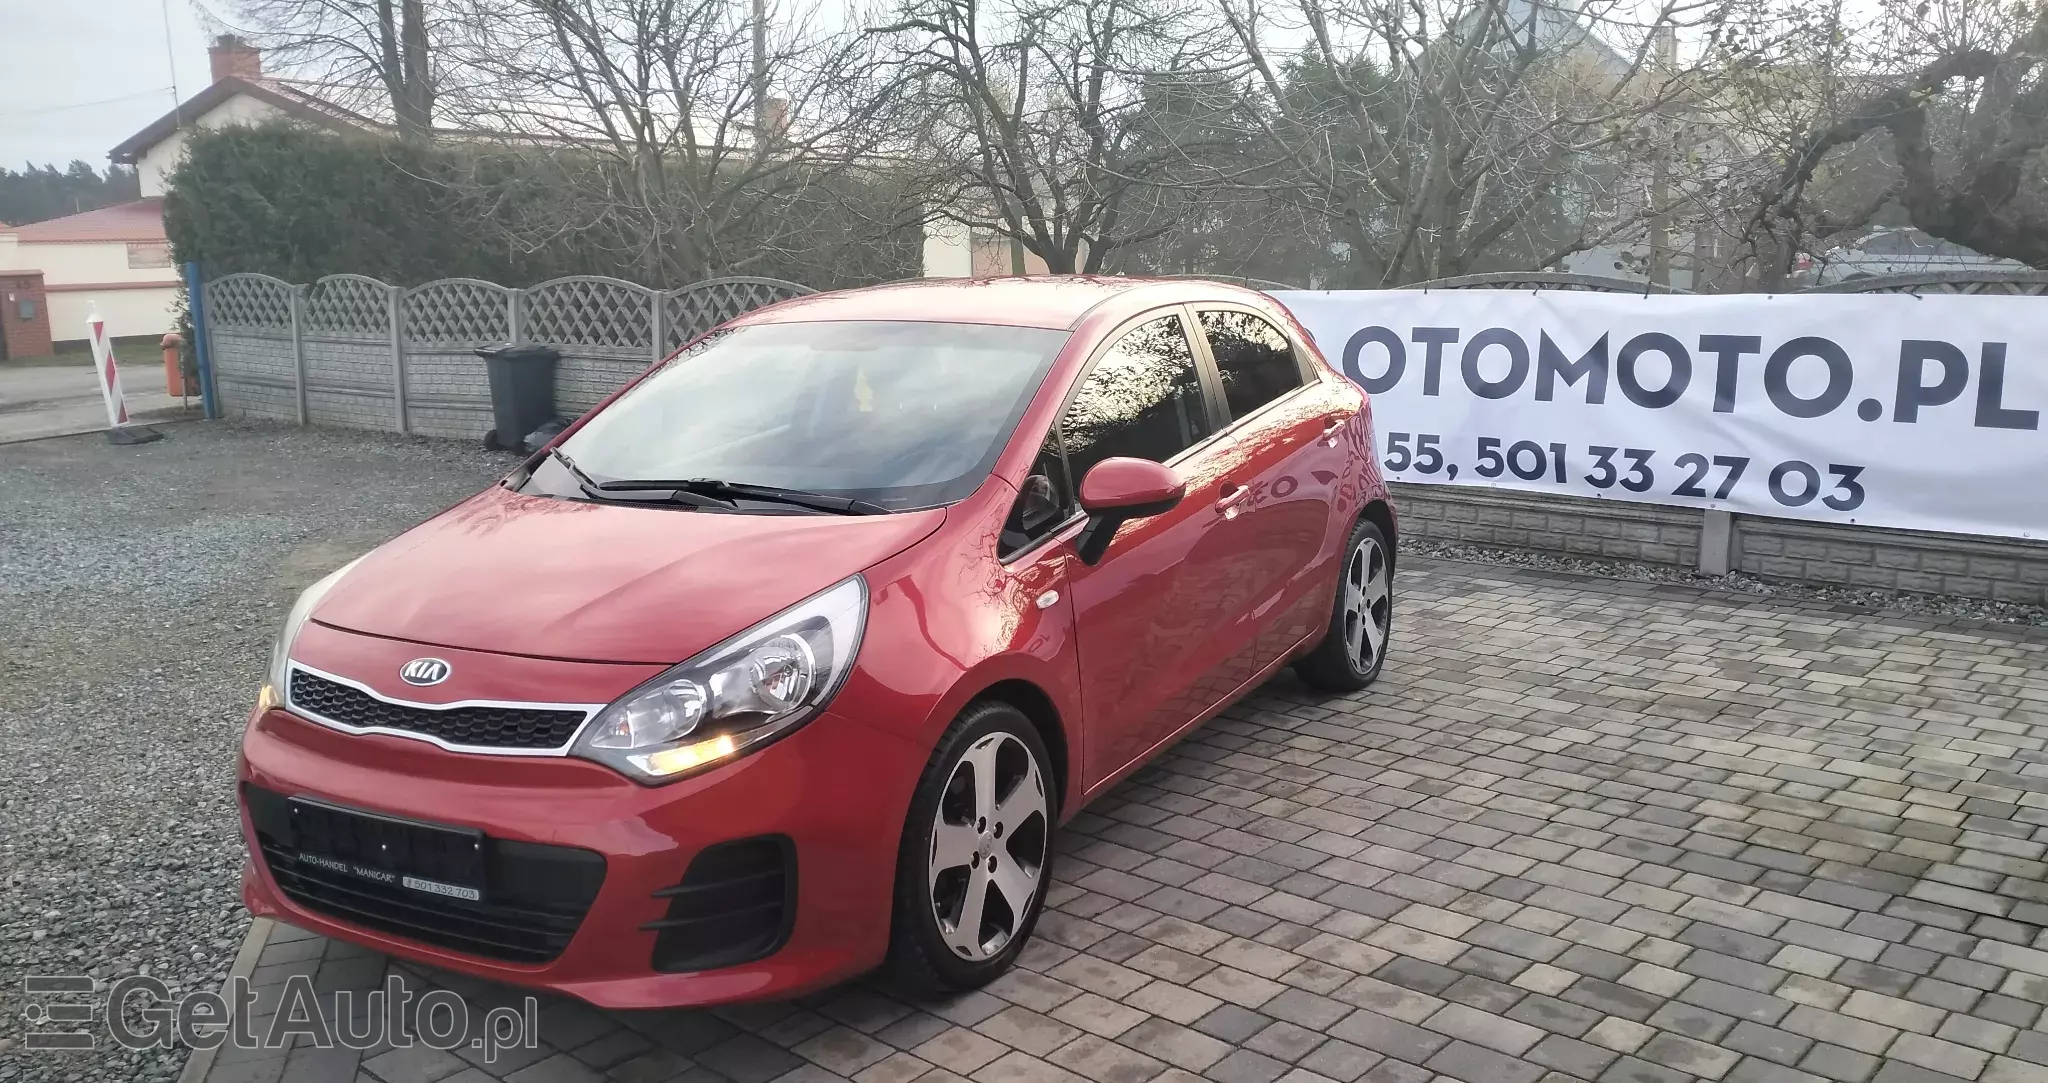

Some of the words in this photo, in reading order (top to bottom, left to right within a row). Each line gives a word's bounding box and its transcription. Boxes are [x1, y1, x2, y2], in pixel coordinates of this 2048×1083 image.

[1383, 432, 1459, 482] 55,
[1474, 438, 1567, 484] 501
[1583, 446, 1656, 494] 33
[1672, 453, 1752, 500] 27
[1768, 460, 1866, 512] 03
[404, 661, 440, 680] KIA
[299, 852, 348, 873] AUTO-HANDEL
[414, 880, 433, 892] 501
[434, 882, 453, 896] 332
[455, 888, 476, 900] 703
